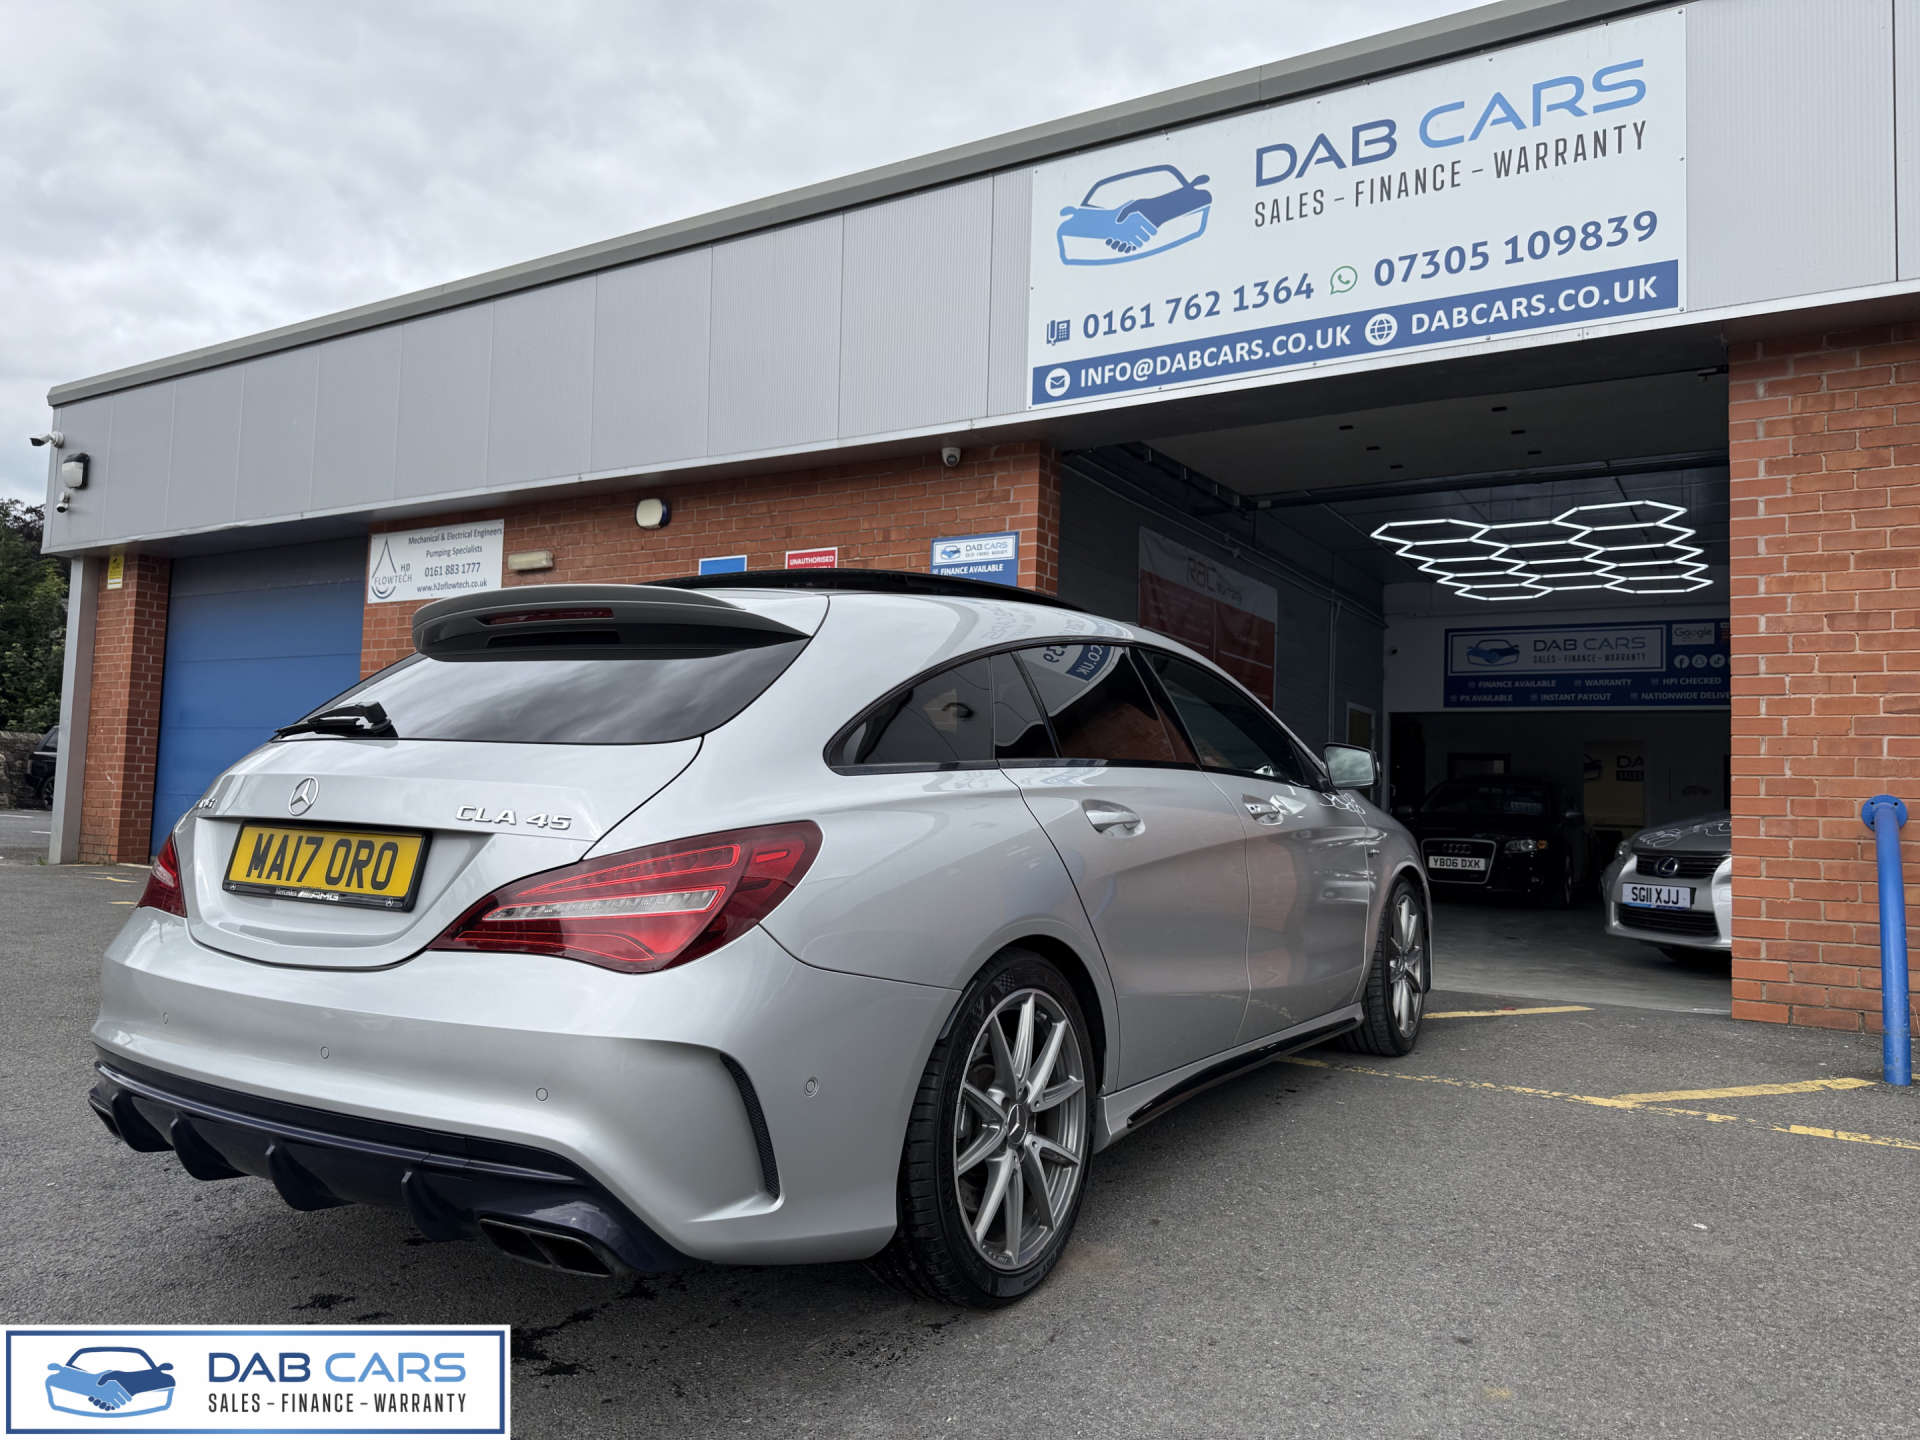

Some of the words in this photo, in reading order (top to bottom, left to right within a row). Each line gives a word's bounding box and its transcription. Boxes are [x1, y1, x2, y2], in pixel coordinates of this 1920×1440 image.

[1255, 118, 1398, 188] DAB
[1418, 58, 1647, 149] CARS
[1254, 189, 1326, 229] SALES
[1354, 160, 1462, 207] FINANCE
[1493, 120, 1648, 179] WARRANTY
[1082, 307, 1155, 340] 0161
[1166, 290, 1221, 325] 762
[1232, 272, 1315, 315] 1364
[1374, 240, 1491, 287] 07305
[1504, 209, 1658, 266] 109839
[1080, 324, 1351, 388] INFO@DABCARS.CO.UK
[1411, 275, 1657, 335] DABCARS.CO.UK
[408, 534, 440, 545] Mechanical
[441, 533, 446, 541] &
[447, 530, 473, 541] Electrical
[474, 527, 503, 538] Engineers
[426, 549, 452, 559] Pumping
[453, 545, 482, 556] Specialists
[424, 566, 443, 578] 0161
[445, 564, 459, 576] 883
[461, 562, 481, 574] 1777
[941, 566, 968, 576] FINANCE
[969, 563, 1004, 573] AVAILABLE
[374, 574, 413, 586] FLOWTECH
[1533, 639, 1577, 652] DAB
[1583, 637, 1646, 650] CARS
[1478, 680, 1512, 688] FINANCE
[1513, 679, 1556, 688] AVAILABLE
[1585, 679, 1632, 687] WARRANTY
[1663, 677, 1678, 686] HPI
[1679, 676, 1722, 685] CHECKED
[1541, 693, 1576, 702] INSTANT
[1577, 692, 1612, 701] PAYOUT
[1641, 691, 1698, 700] NATIONWIDE
[456, 805, 517, 826] CLA
[525, 813, 573, 830] 45
[246, 832, 323, 884] MA17
[324, 839, 399, 891] ORO
[1433, 857, 1458, 868] YB06
[1461, 859, 1480, 869] DXK
[1632, 886, 1652, 903] SG11
[1655, 888, 1679, 905] XJJ
